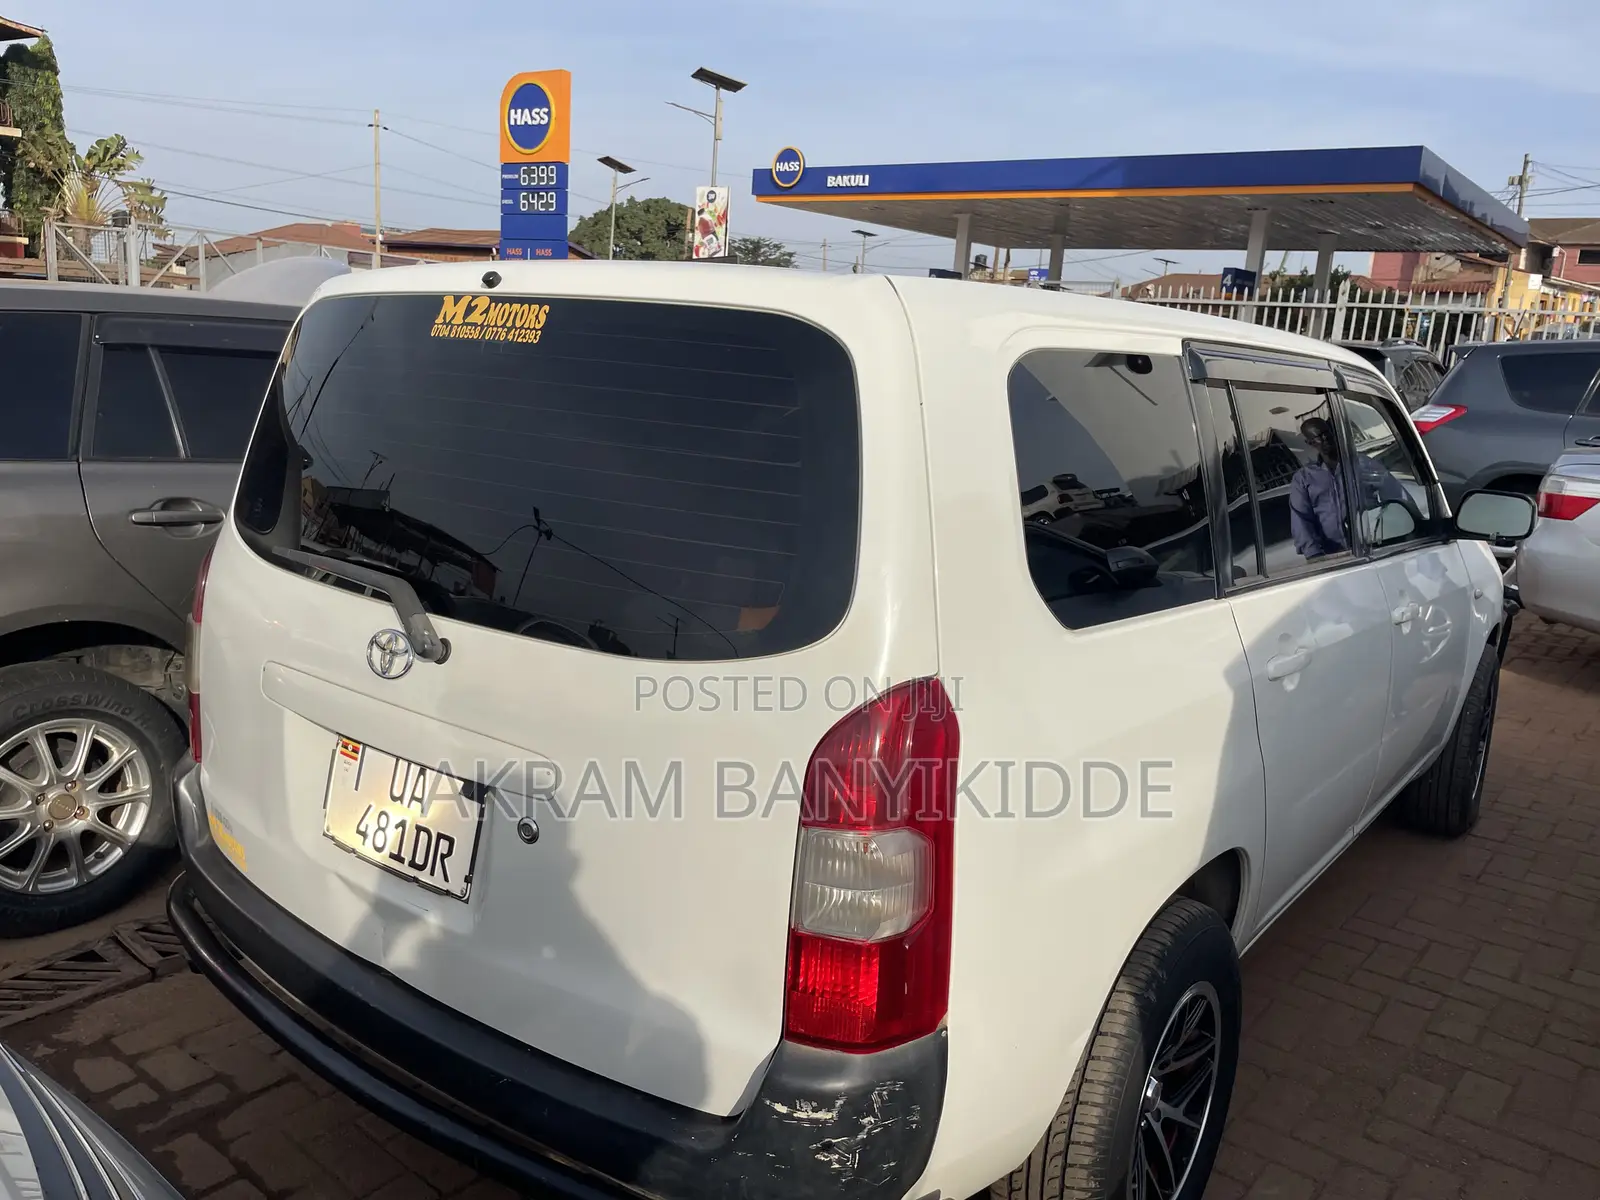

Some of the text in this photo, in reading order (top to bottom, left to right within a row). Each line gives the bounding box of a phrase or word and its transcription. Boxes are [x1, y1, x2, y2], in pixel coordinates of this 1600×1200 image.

[510, 108, 549, 125] HASS
[520, 165, 556, 185] 6399
[776, 161, 800, 172] HASS
[827, 175, 869, 187] BAKULI
[520, 192, 556, 211] 6429
[506, 247, 523, 256] HASS
[535, 248, 553, 257] HASS
[1222, 273, 1232, 287] 4
[435, 296, 549, 329] M2 MOTORS
[431, 325, 451, 337] 0704
[485, 327, 507, 341] 0776
[507, 328, 541, 343] 412393
[390, 758, 427, 813] UA
[356, 804, 456, 882] 481DR
